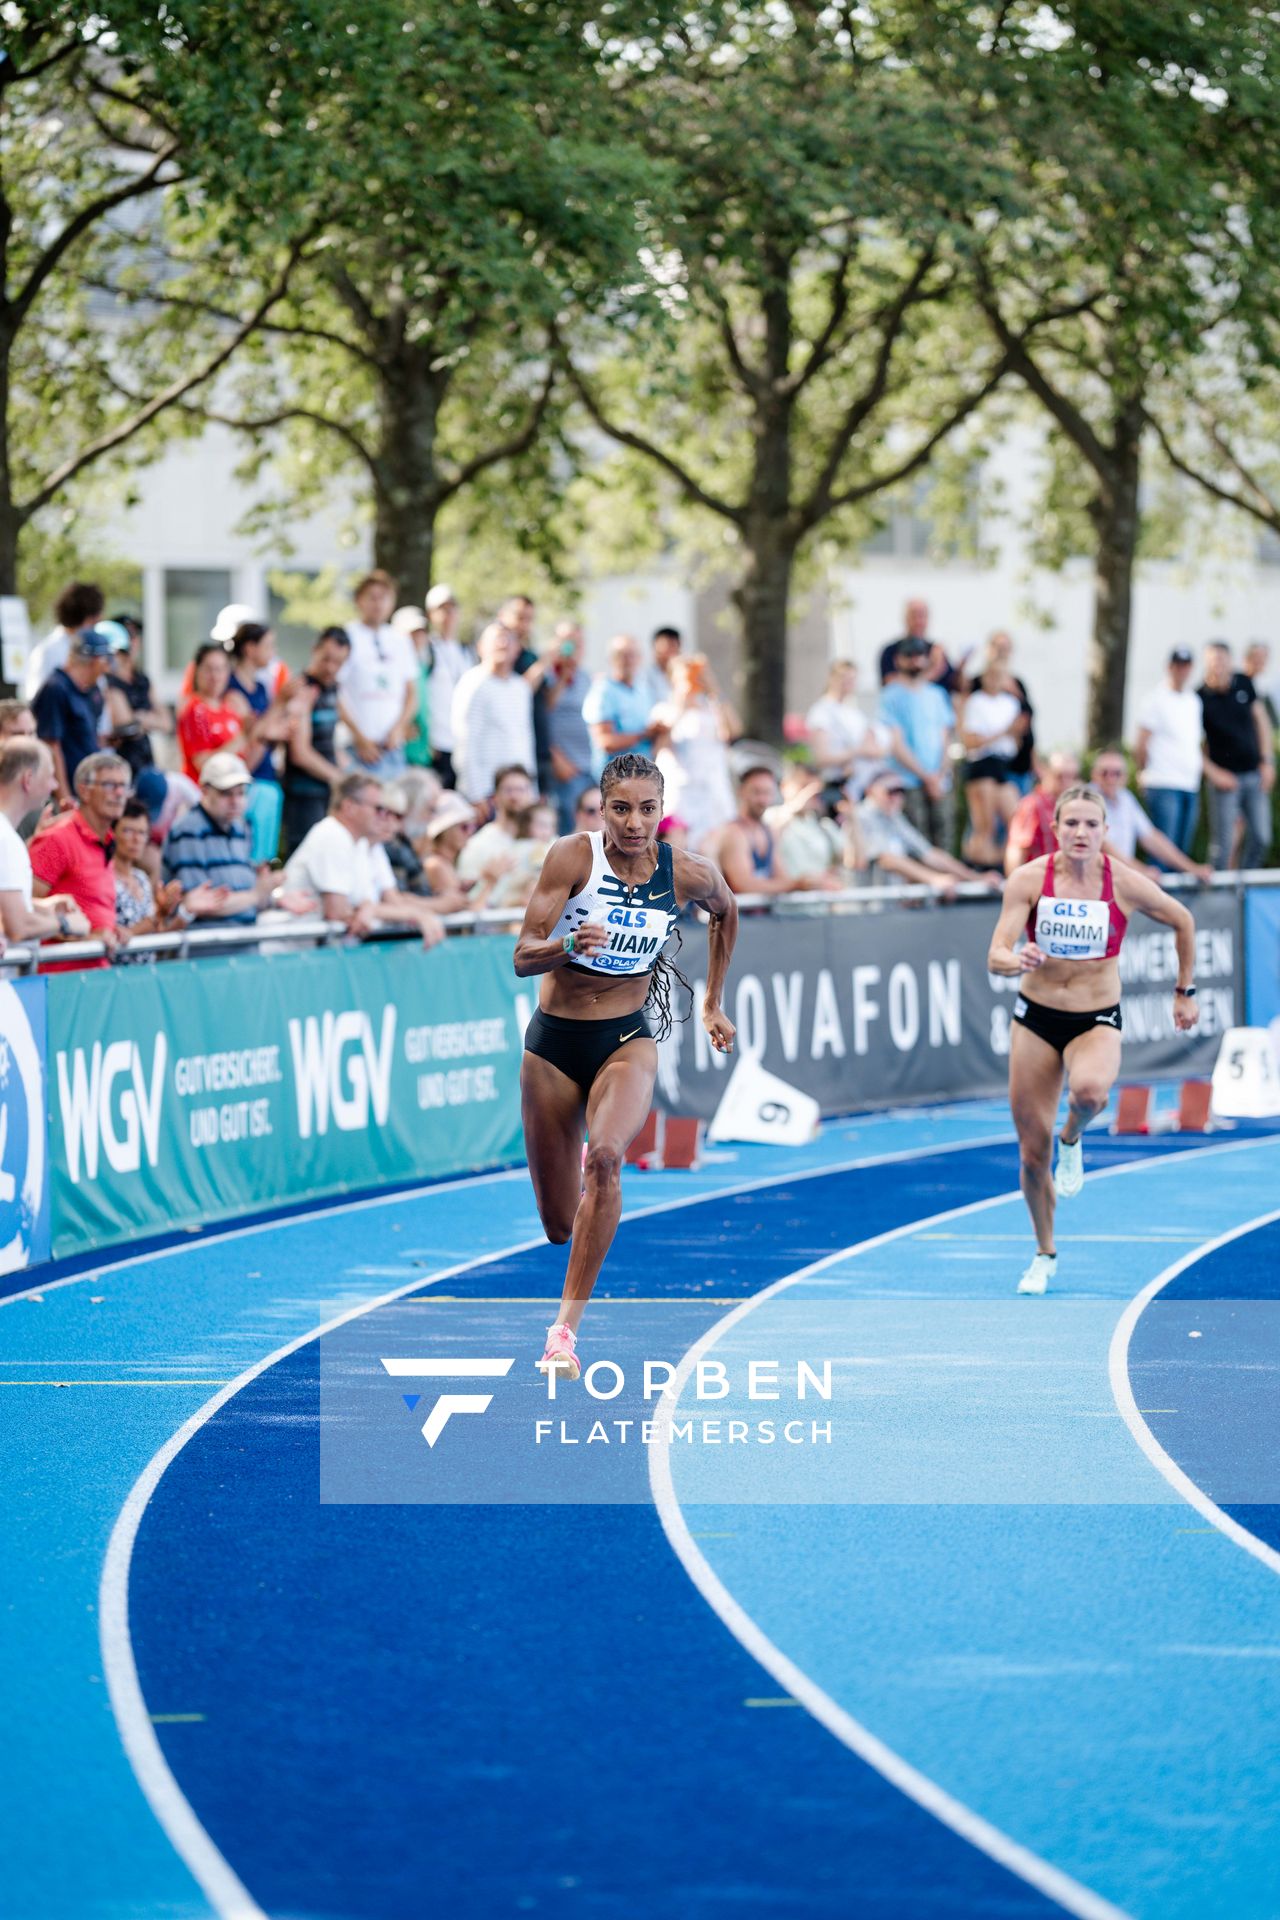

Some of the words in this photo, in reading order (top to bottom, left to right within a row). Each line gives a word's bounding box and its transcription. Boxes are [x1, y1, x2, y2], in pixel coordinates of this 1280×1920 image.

[607, 908, 648, 928] GLS
[1053, 903, 1088, 917] GLS
[1039, 920, 1104, 940] GRIMM
[602, 931, 658, 954] HIAM
[288, 1002, 398, 1139] WGV
[1230, 1048, 1245, 1081] 5
[55, 1029, 168, 1184] WGV
